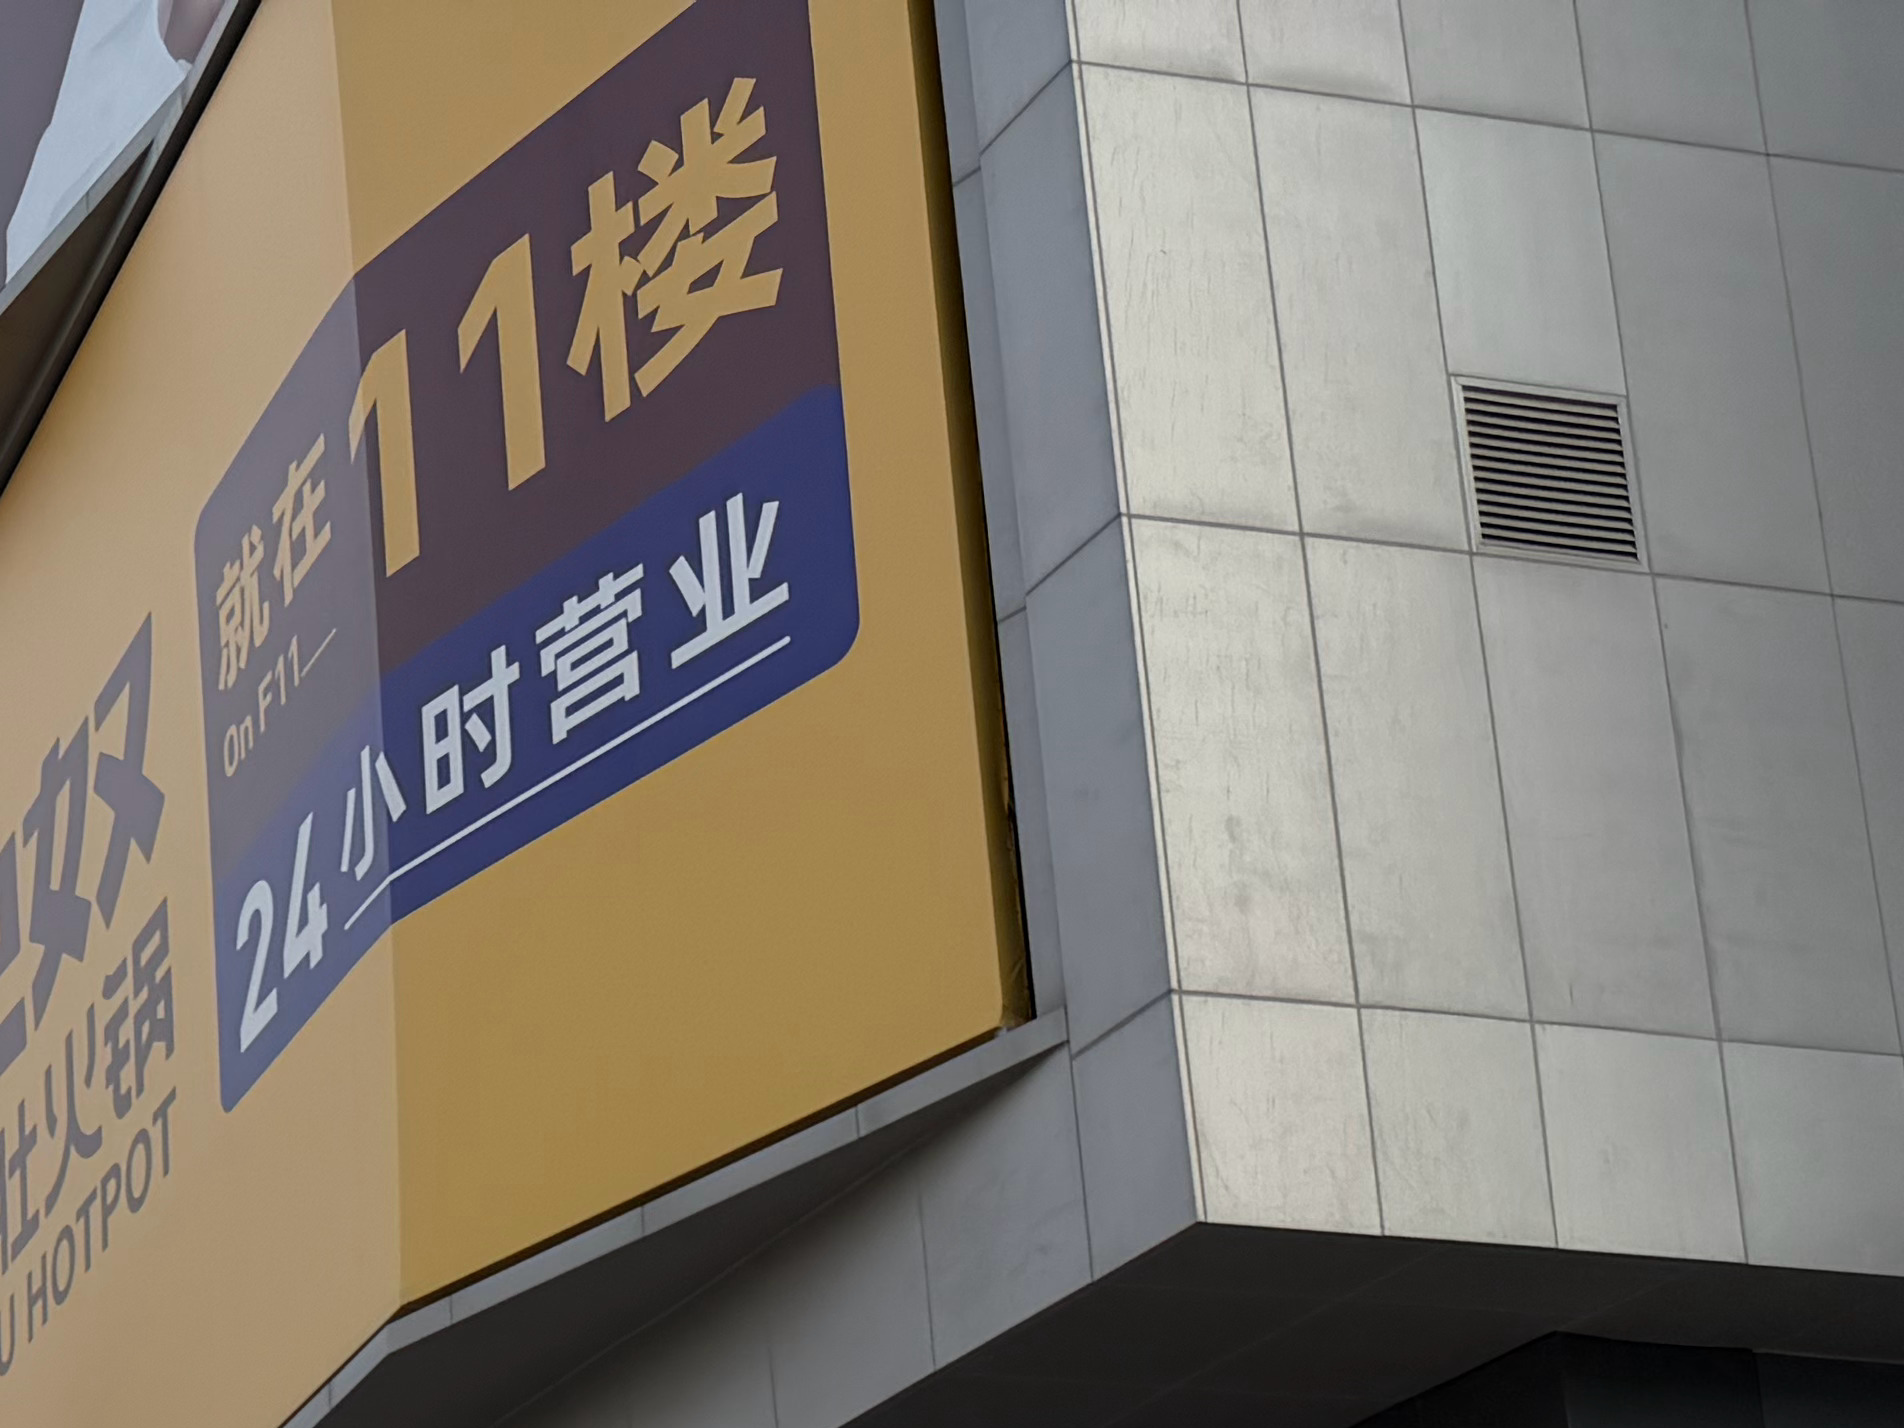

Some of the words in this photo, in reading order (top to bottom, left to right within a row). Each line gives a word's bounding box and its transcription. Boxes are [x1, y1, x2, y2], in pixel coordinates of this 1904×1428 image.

[214, 433, 332, 691] 就在
[348, 77, 783, 578] 11楼
[223, 721, 255, 778] On
[235, 493, 789, 1054] 24小时营业
[26, 1086, 178, 1344] HOTPOT
